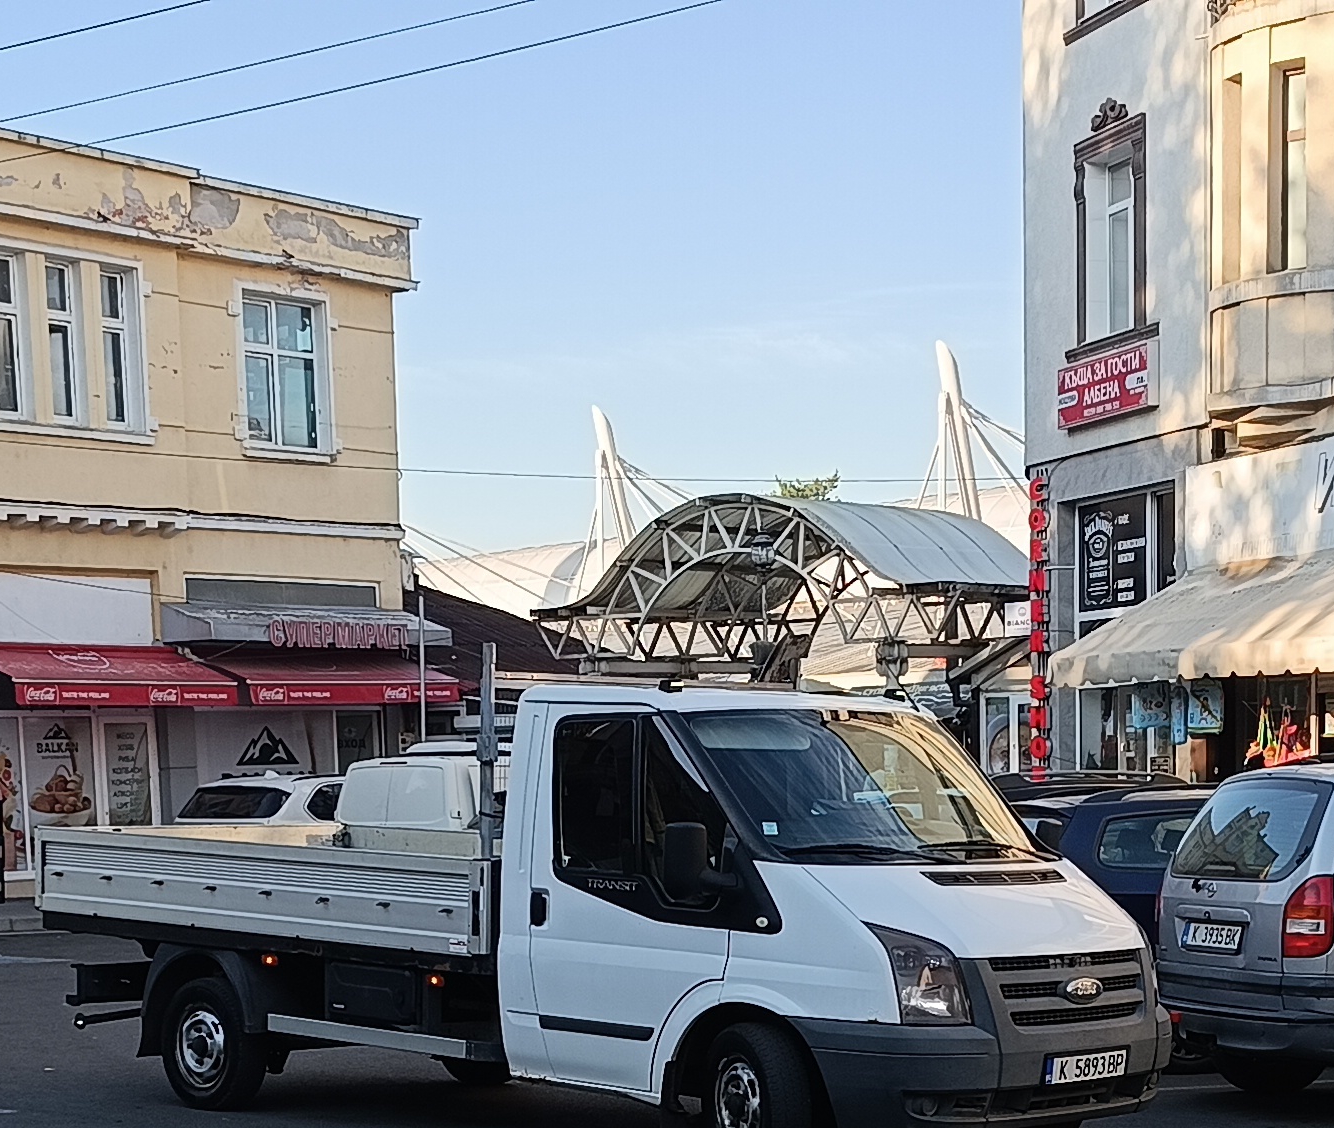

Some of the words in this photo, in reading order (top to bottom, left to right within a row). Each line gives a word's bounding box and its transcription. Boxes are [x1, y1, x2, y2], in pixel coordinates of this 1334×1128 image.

[1064, 365, 1093, 390] КЪЩА
[1093, 360, 1107, 382] ЗА
[1107, 350, 1140, 378] ГОСТИ
[1083, 379, 1121, 407] АЛБЕНА
[36, 741, 79, 753] BALKAN
[587, 878, 639, 891] TRANSIT
[1191, 925, 1201, 943] K
[1058, 1059, 1069, 1081] K
